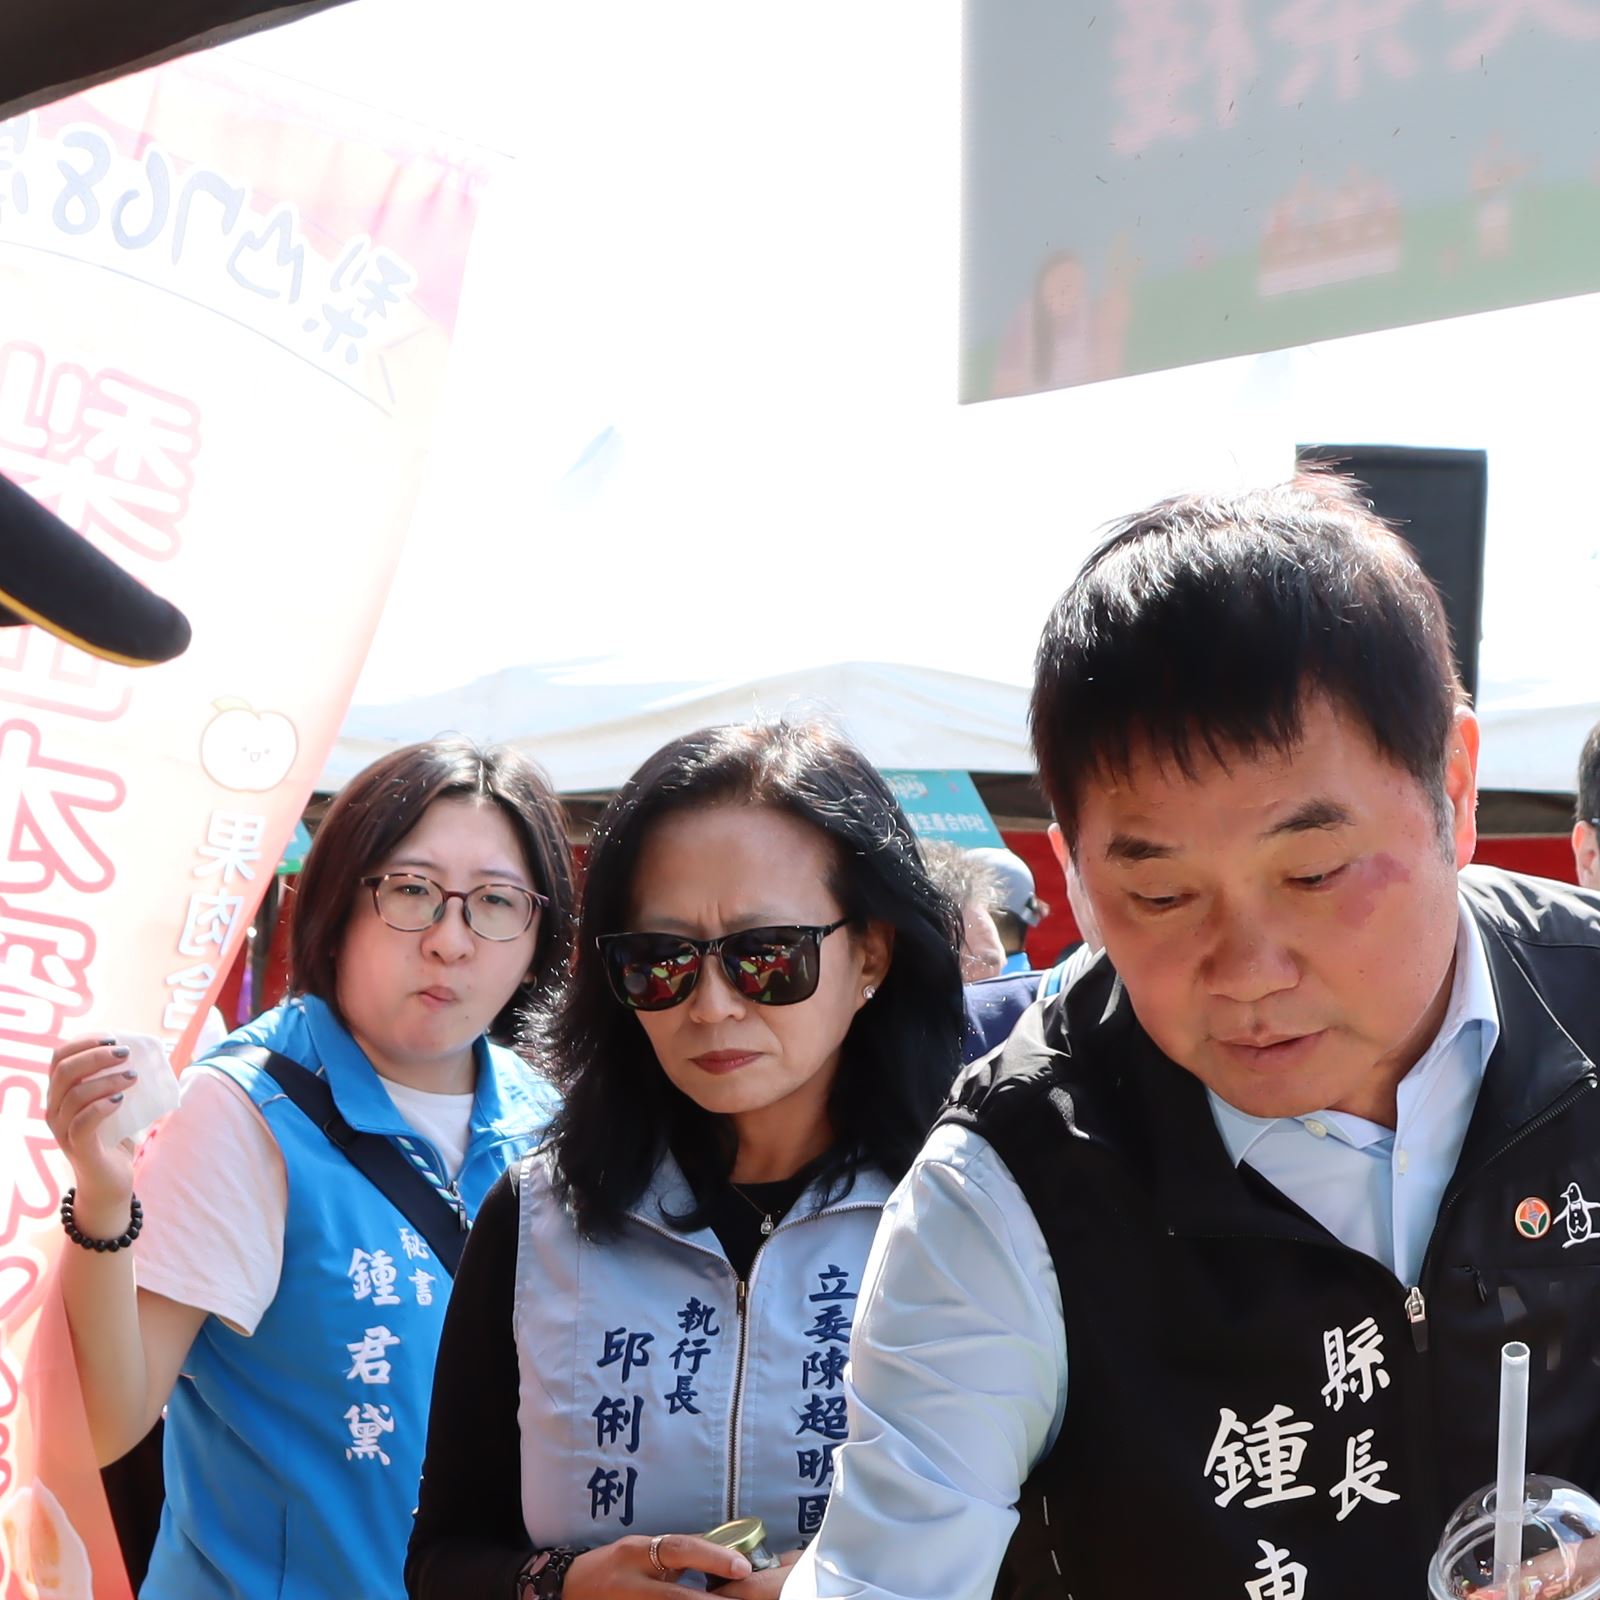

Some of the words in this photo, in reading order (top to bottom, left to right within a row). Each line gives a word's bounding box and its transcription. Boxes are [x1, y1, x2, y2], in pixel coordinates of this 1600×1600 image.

[342, 1246, 402, 1467] 鍾君黛
[398, 1227, 437, 1306] 秘書
[663, 1295, 721, 1416] 執行長
[586, 1325, 656, 1527] 邱俐俐
[1319, 1316, 1401, 1523] 縣長
